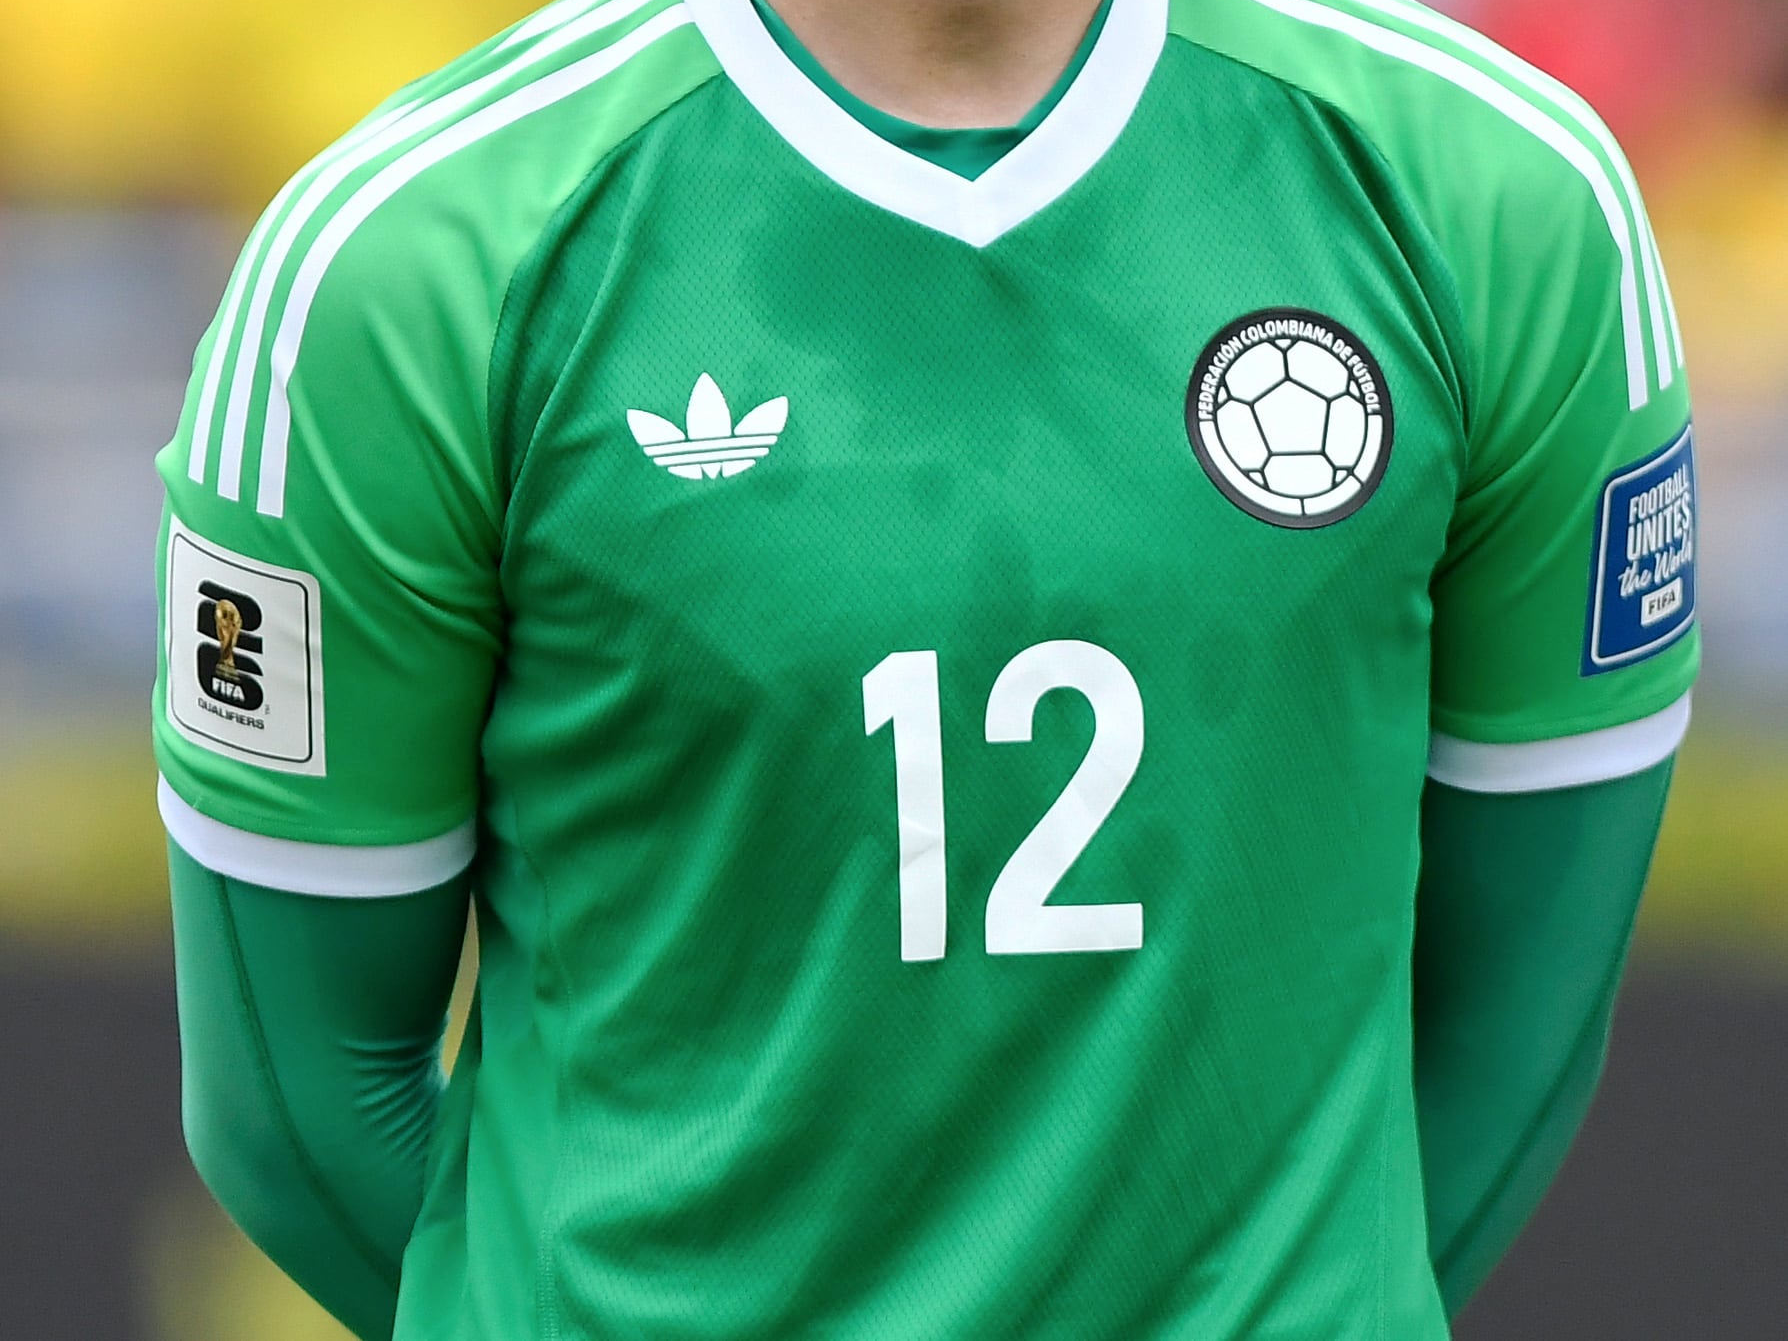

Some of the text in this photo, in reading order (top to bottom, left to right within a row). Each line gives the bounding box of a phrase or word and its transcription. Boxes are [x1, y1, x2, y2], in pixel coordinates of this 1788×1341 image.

[1198, 319, 1381, 420] FEDERACIÓN COLOMBIANA DE FÚTBOL
[1628, 463, 1689, 524] FOOTBALL
[1626, 491, 1693, 562] UNITES
[1618, 529, 1693, 599] the World
[1648, 591, 1676, 615] FIFA
[197, 697, 265, 730] QUALIFIERS
[212, 677, 246, 703] FIFA
[862, 639, 1144, 962] 12
